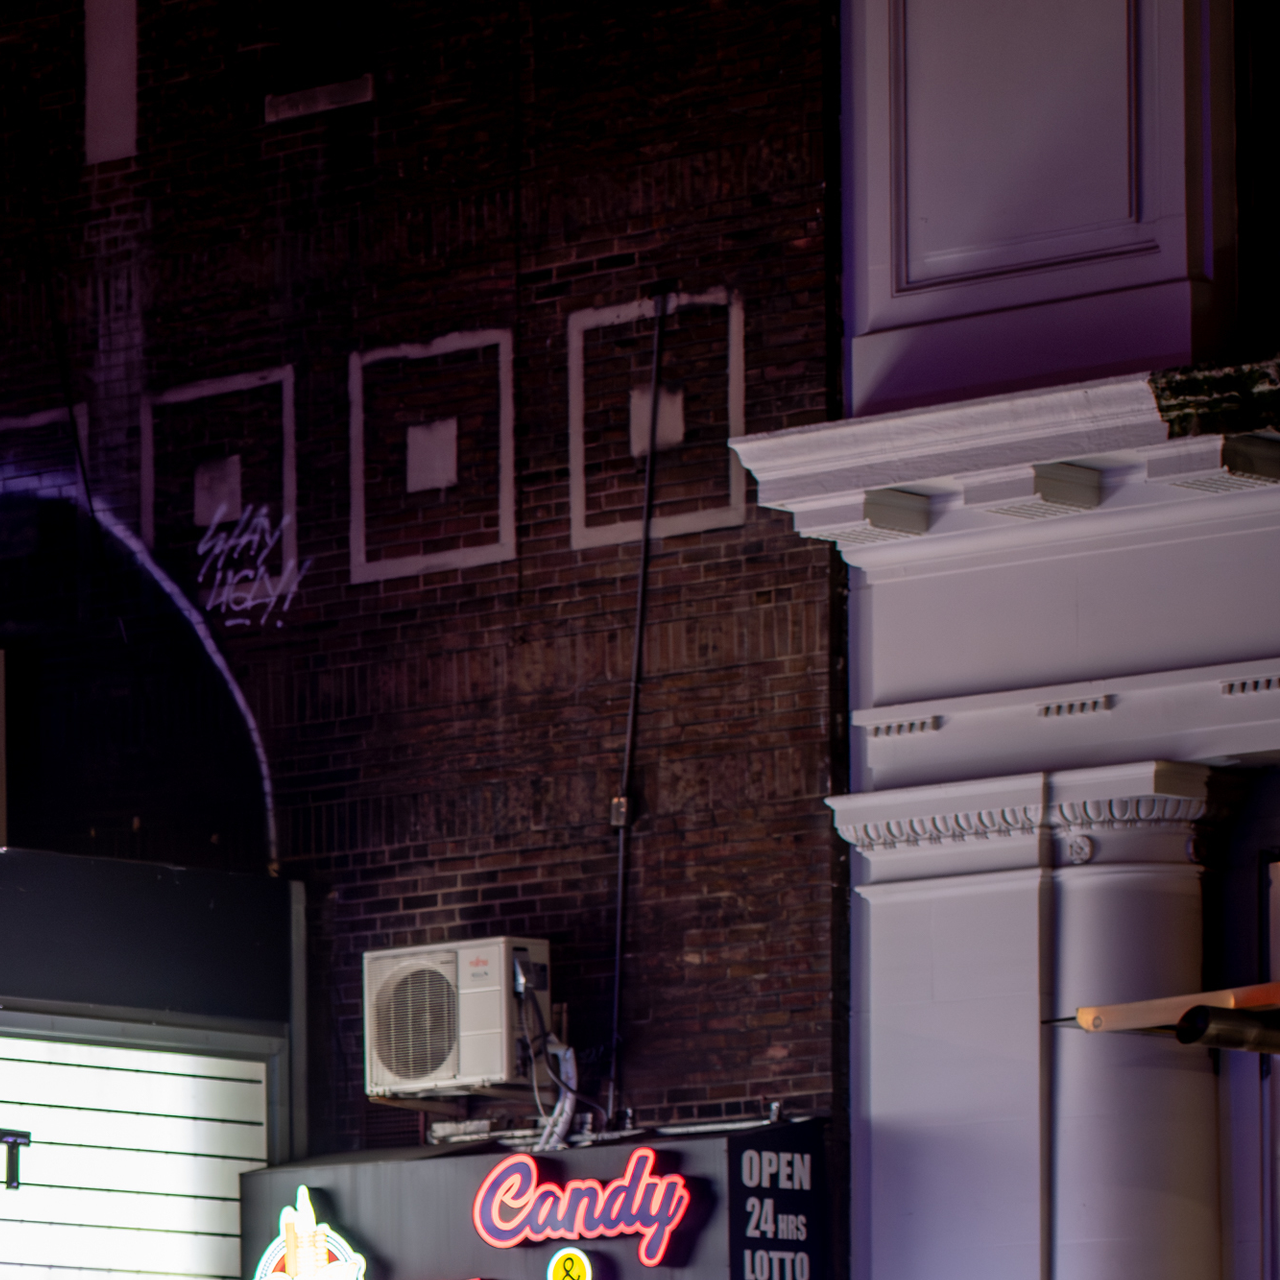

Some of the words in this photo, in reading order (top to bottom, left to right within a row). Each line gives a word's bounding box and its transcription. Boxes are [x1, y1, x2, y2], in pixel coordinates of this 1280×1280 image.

[742, 1149, 811, 1191] OPEN
[472, 1147, 692, 1268] Candy
[745, 1198, 775, 1240] 24
[778, 1214, 807, 1241] HRS
